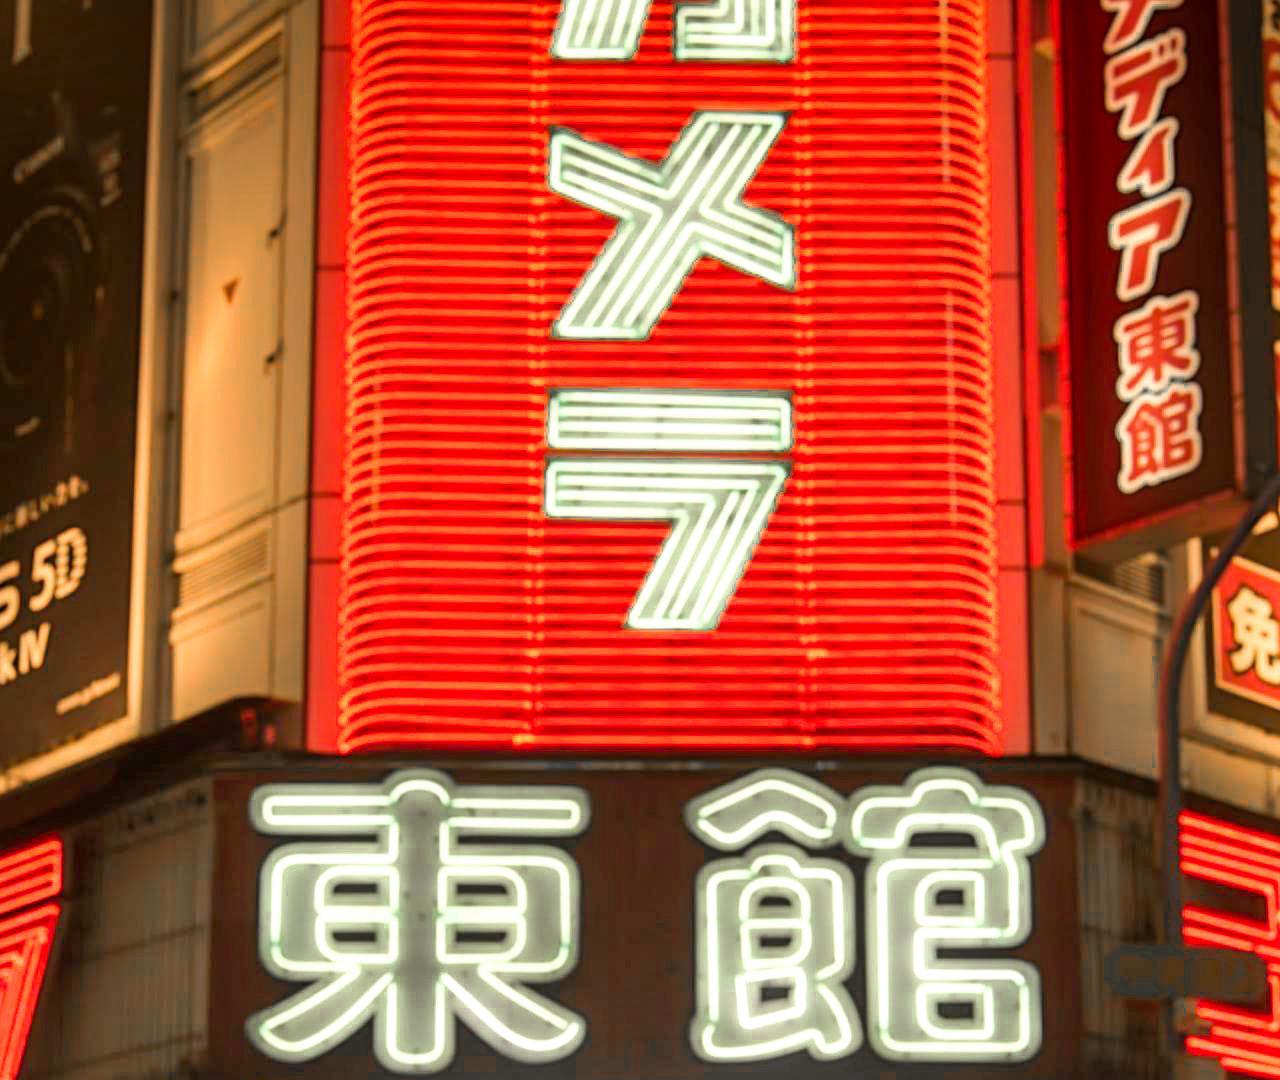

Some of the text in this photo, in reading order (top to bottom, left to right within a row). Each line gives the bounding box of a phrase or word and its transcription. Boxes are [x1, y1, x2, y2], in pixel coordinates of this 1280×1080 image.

[544, 0, 800, 632] メラ
[18, 622, 51, 674] IV
[29, 526, 87, 612] 5D
[247, 766, 1046, 1073] 東館
